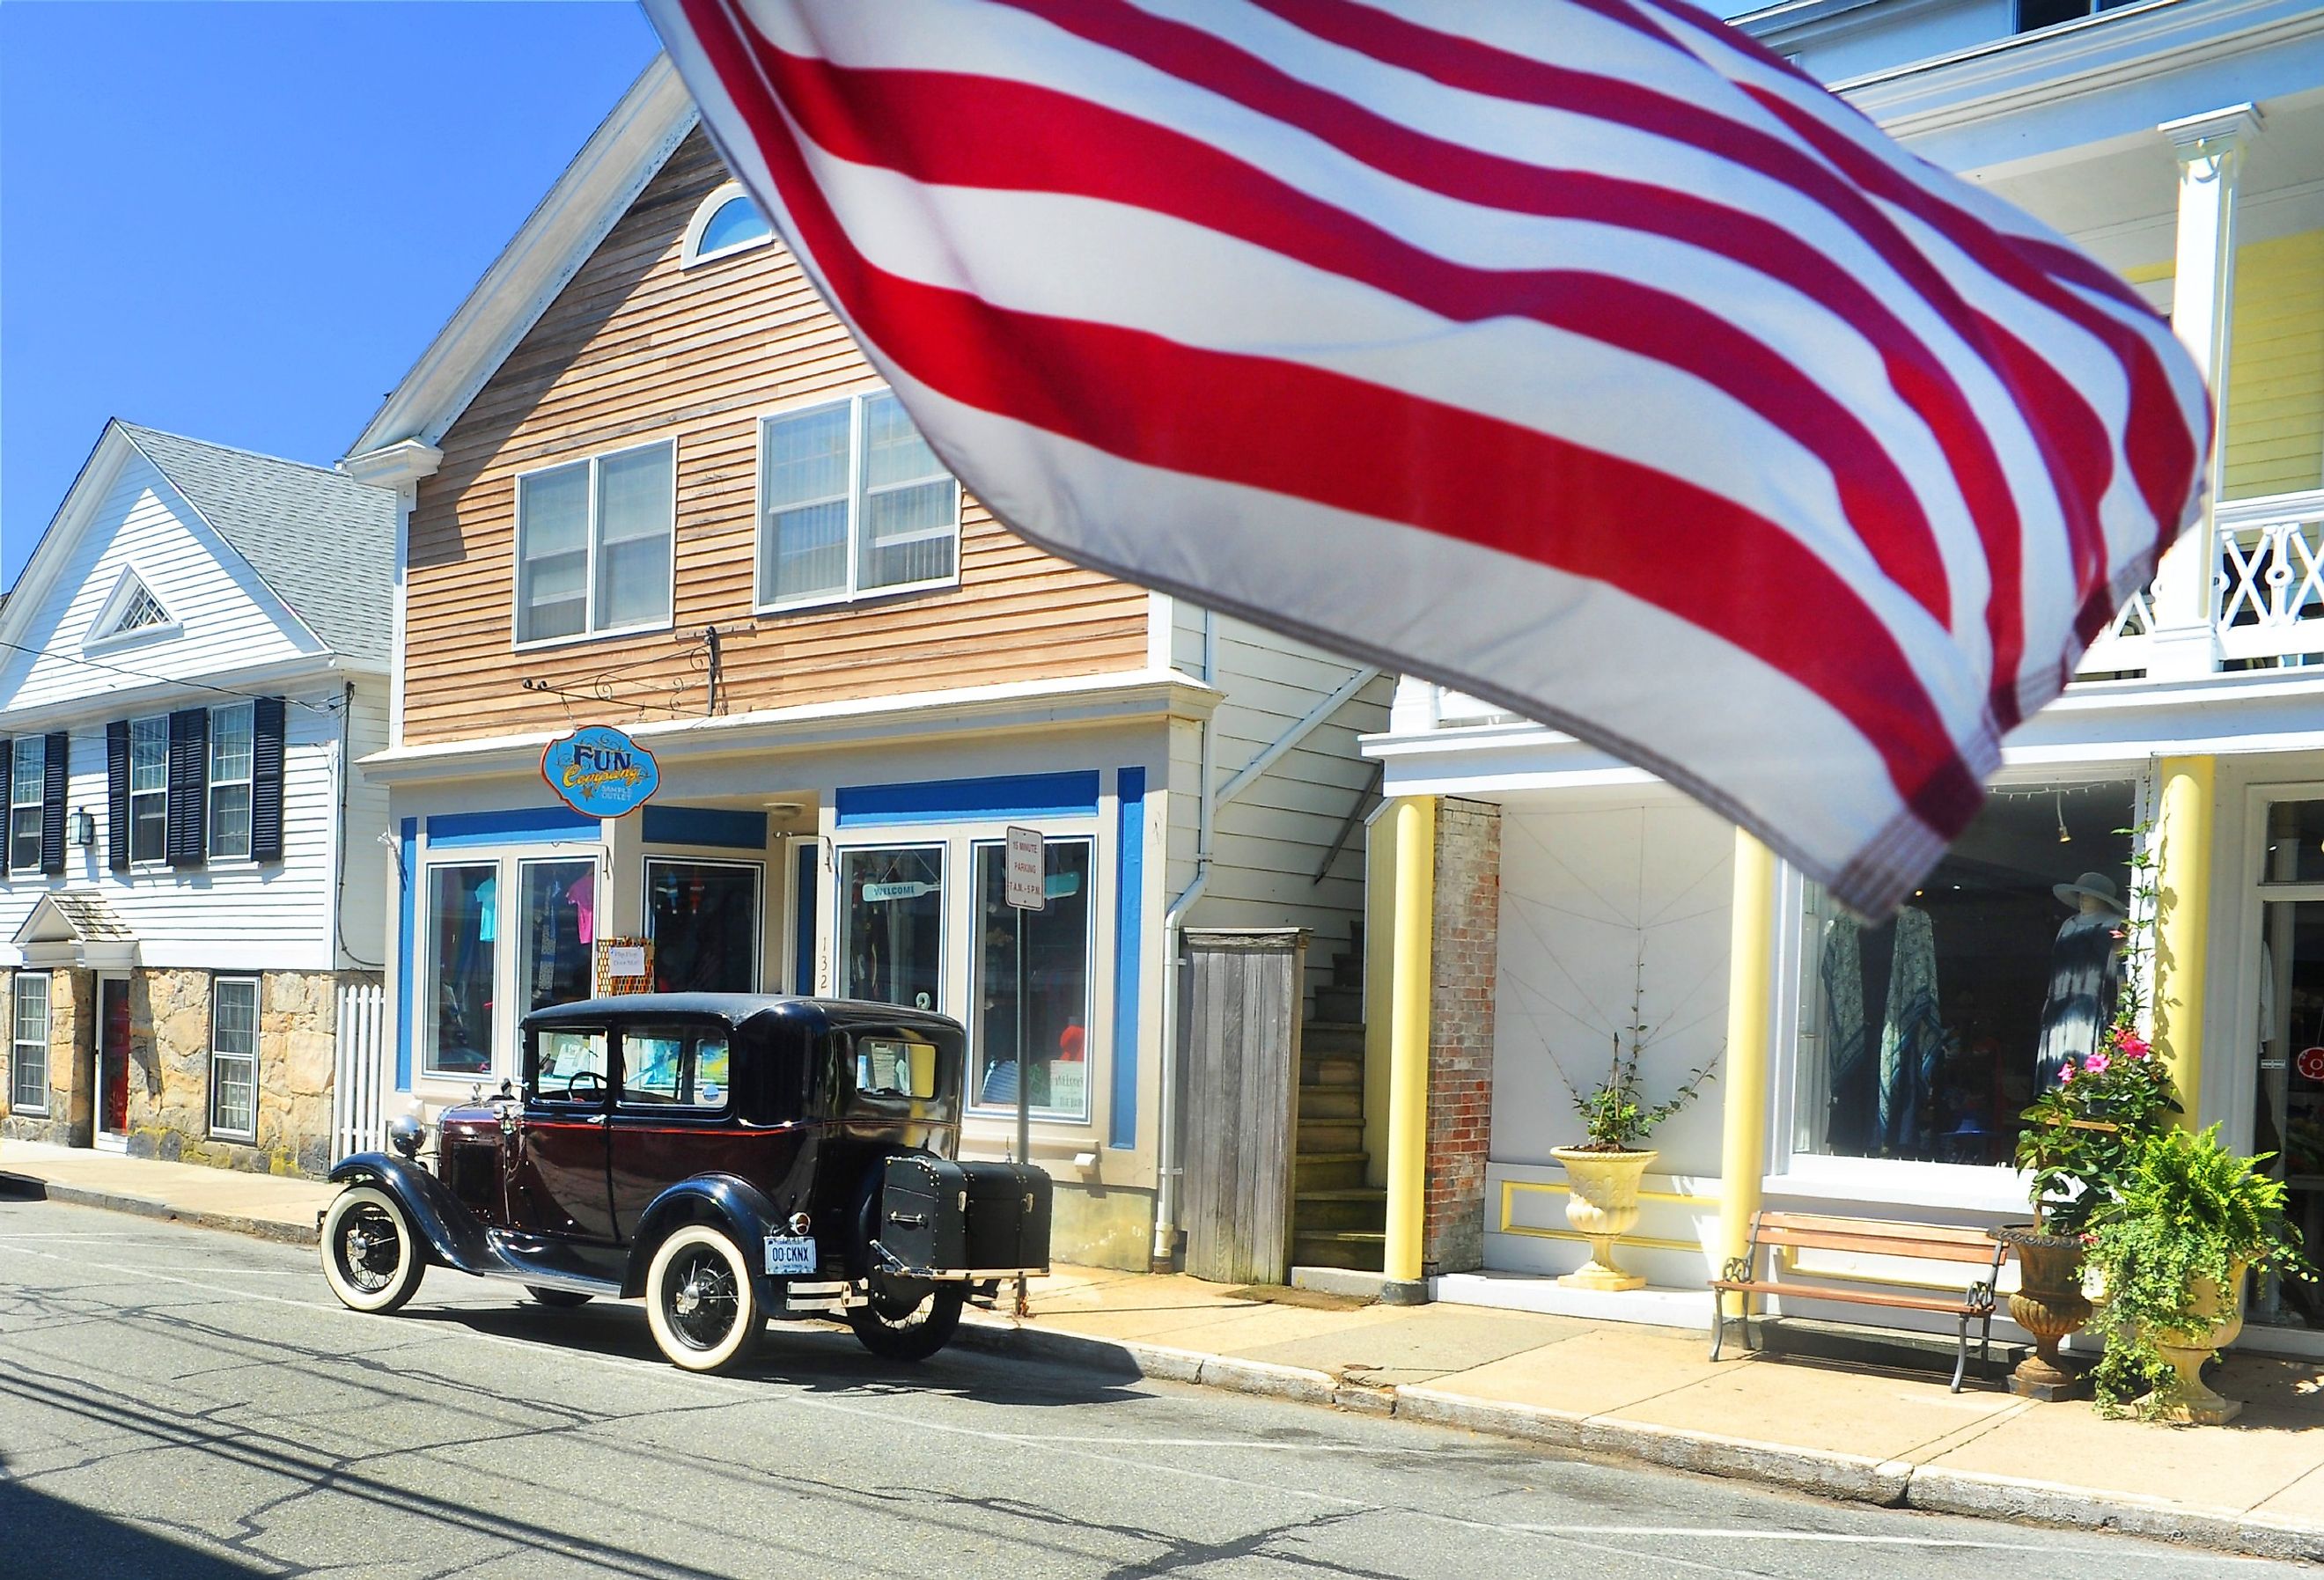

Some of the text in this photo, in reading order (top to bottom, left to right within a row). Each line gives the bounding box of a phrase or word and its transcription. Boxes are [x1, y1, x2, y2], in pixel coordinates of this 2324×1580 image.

[573, 745, 632, 771] FUN
[563, 765, 639, 789] Company
[1012, 841, 1038, 854] 15 MINUTE
[1014, 862, 1036, 874] PARKING
[873, 885, 916, 896] WELCOME
